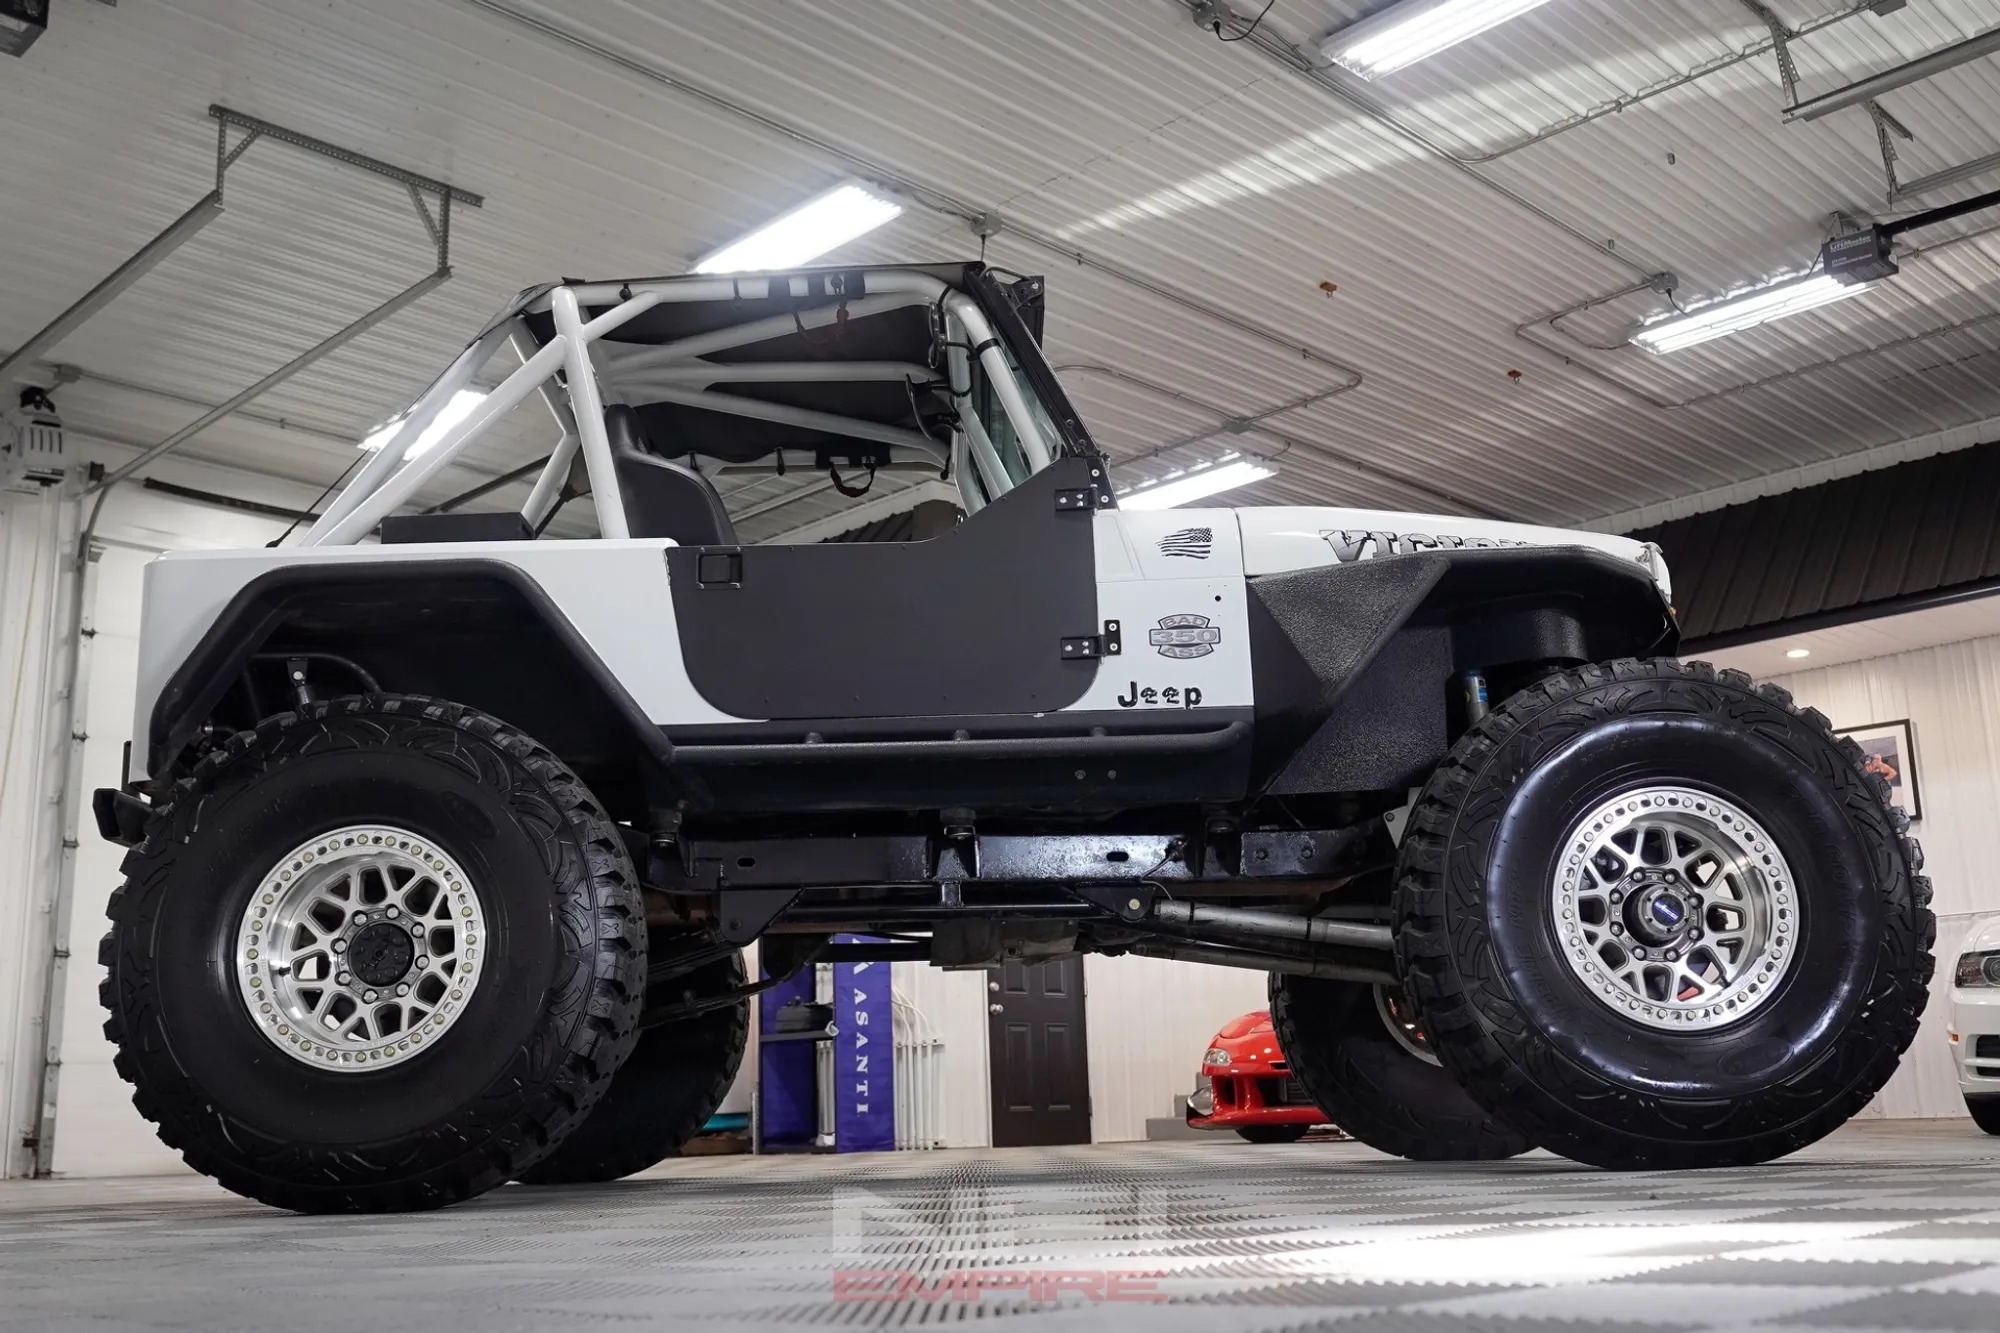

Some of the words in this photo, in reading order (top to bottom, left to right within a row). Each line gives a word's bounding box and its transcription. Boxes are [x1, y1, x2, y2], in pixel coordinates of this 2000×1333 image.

[1162, 616, 1206, 629] BAD
[1152, 630, 1218, 643] 350
[1160, 645, 1211, 658] ASS
[1117, 680, 1202, 709] Jeep
[854, 988, 869, 1114] ASANTI
